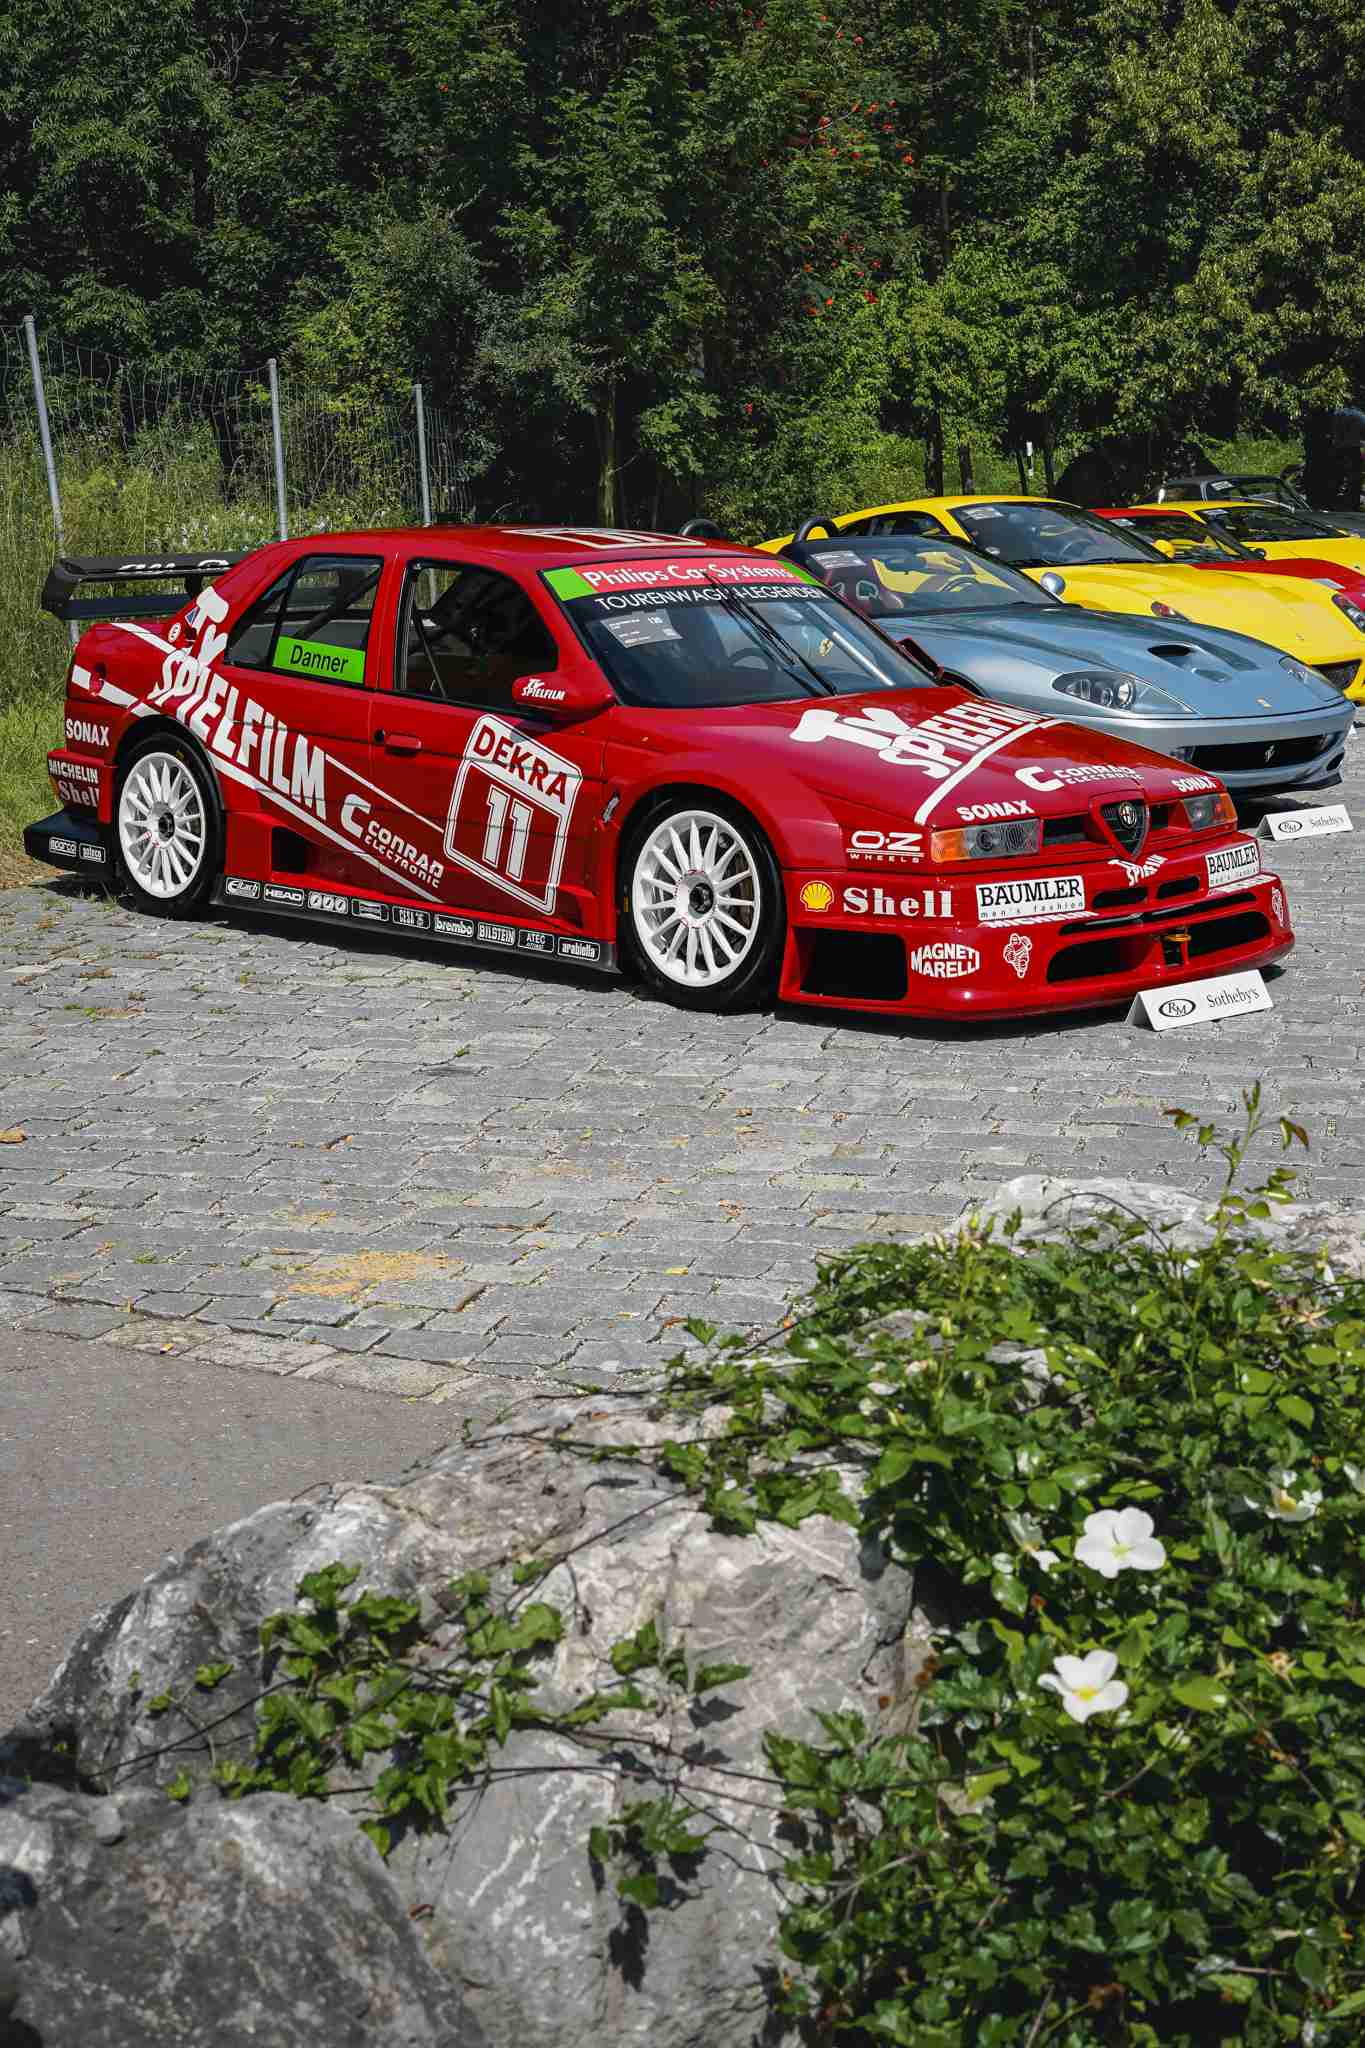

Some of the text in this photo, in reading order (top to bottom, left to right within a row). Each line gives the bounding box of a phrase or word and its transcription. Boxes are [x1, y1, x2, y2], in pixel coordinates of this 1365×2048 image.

[582, 567, 669, 588] Philips
[707, 562, 793, 582] Systems
[289, 643, 350, 675] Danner
[521, 686, 566, 701] SPIELFILM
[66, 718, 110, 747] SONAX
[147, 646, 327, 820] SPIELFILM
[878, 702, 1058, 780] SPIELFILM
[49, 759, 99, 784] MICHELIN
[473, 724, 568, 805] DEKRA
[58, 780, 100, 808] Shell
[1171, 775, 1217, 793] SONAX
[956, 799, 1035, 822] SONAX
[482, 784, 534, 883] 11
[367, 820, 445, 879] CONRAD
[849, 853, 920, 863] WHEELS
[264, 888, 303, 902] HEAD
[843, 887, 955, 918] Shell
[978, 878, 1082, 907] BÄUMLER
[435, 914, 473, 936] brembo
[479, 924, 516, 944] BILSTEIN
[1206, 987, 1261, 1008] Sotheby's
